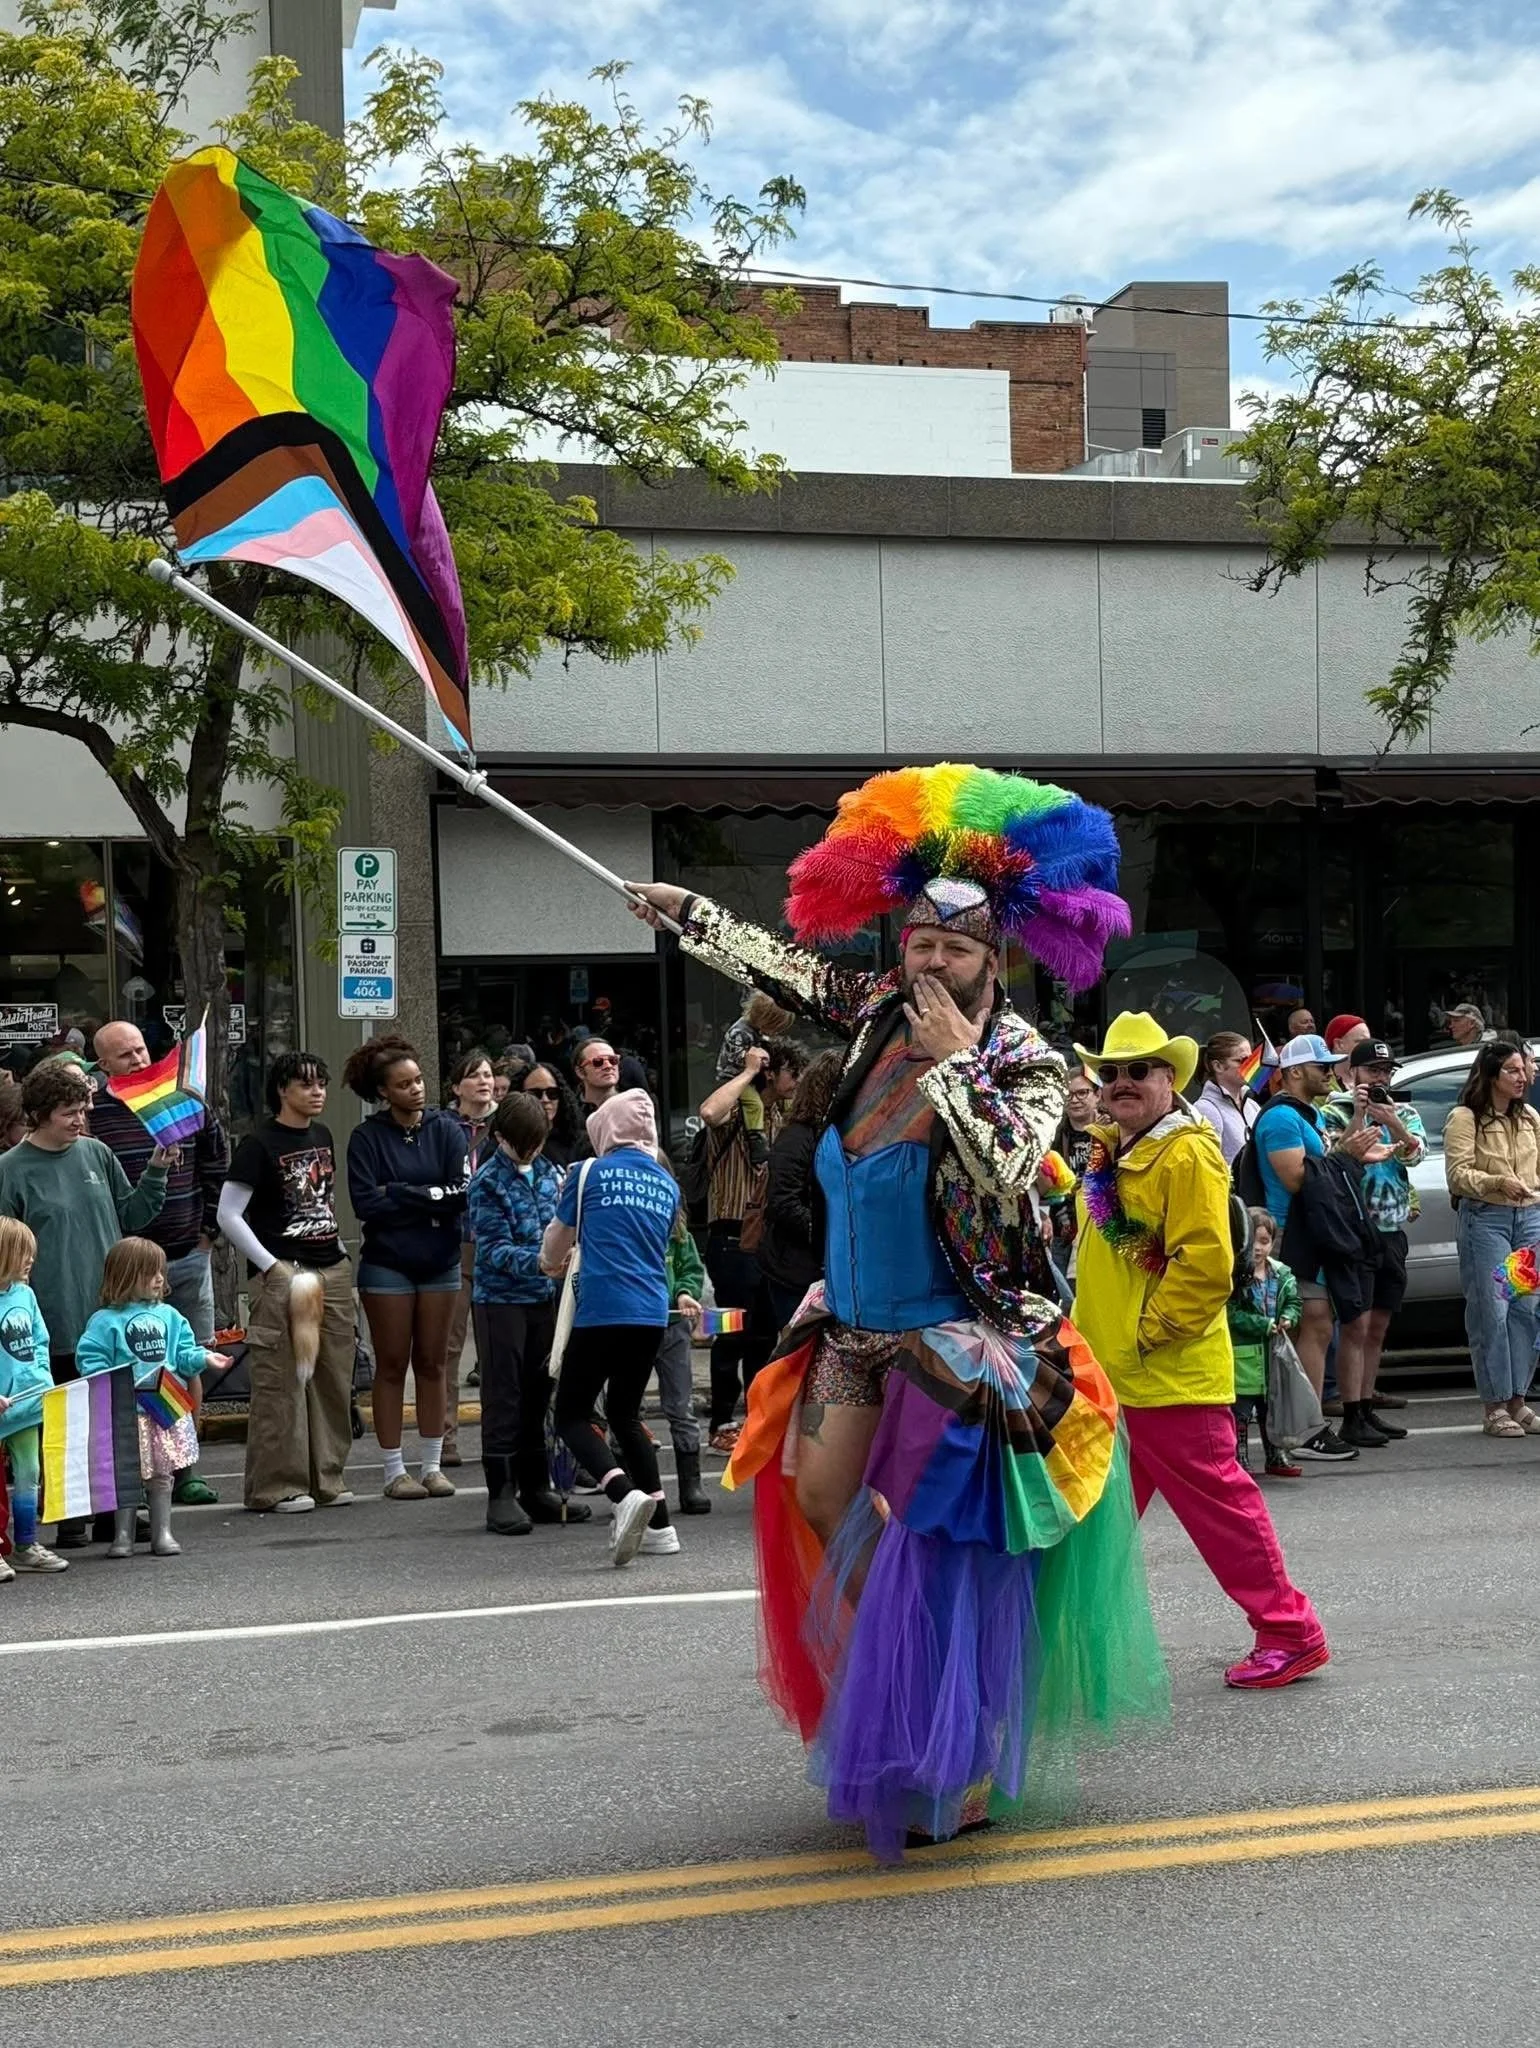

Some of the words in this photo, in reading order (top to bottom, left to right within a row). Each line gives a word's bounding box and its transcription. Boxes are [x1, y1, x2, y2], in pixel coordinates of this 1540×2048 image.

[357, 880, 379, 890] PAY
[344, 892, 392, 903] PARKING
[353, 987, 382, 997] 4061
[27, 1022, 48, 1032] POST
